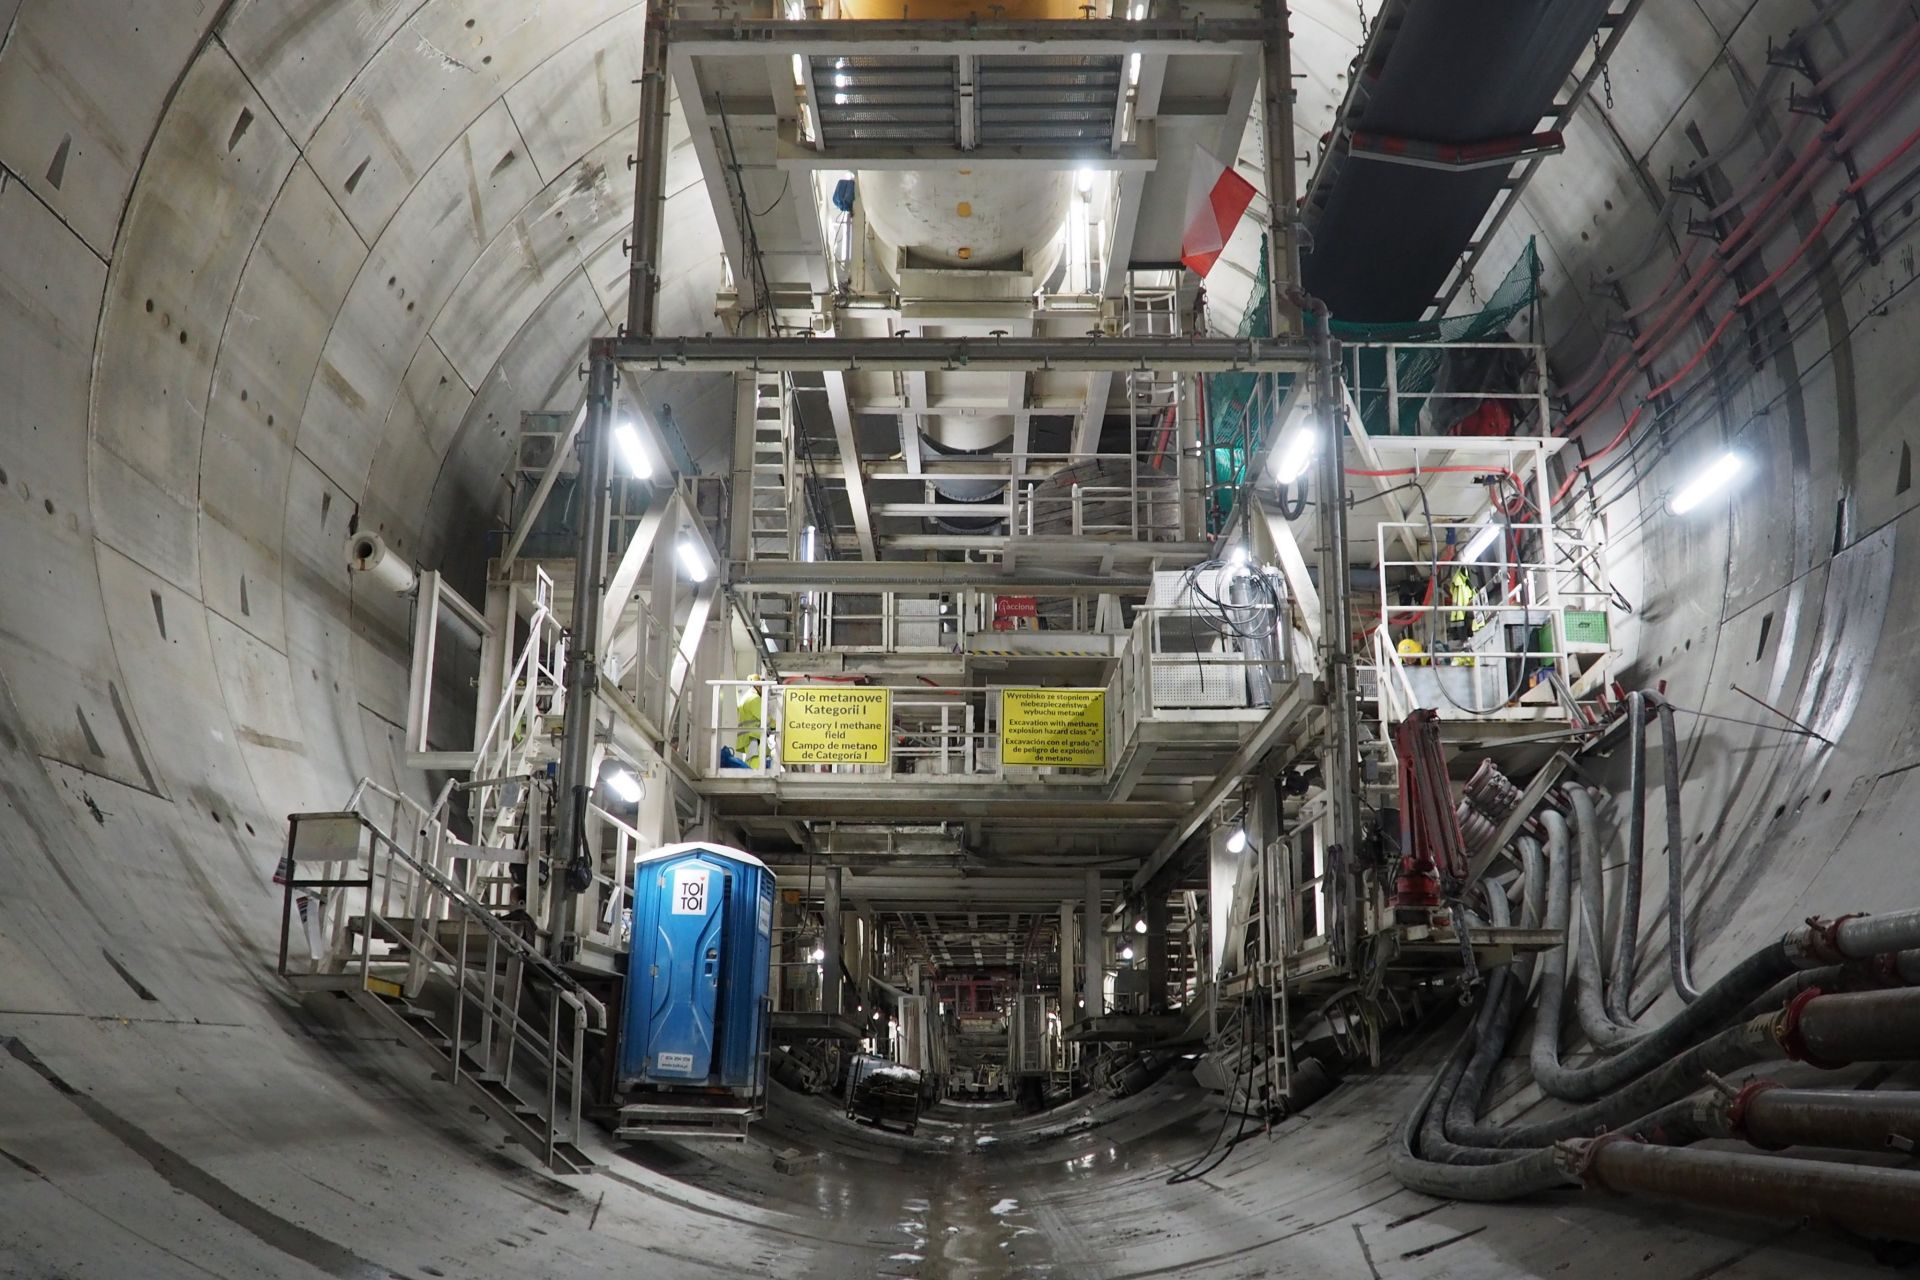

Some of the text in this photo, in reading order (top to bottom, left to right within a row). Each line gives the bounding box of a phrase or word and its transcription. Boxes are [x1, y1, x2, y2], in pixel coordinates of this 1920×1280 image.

[1006, 602, 1034, 611] acciona
[790, 692, 882, 703] Pole metanowe
[1006, 692, 1046, 702] Wyrobisko
[1056, 693, 1090, 702] stopniem
[804, 704, 867, 716] Kategorii I
[1020, 701, 1088, 710] niebezpieczeństwa
[1024, 708, 1085, 717] wybuchu metanu
[789, 720, 882, 731] Category I methane
[1009, 719, 1048, 727] Excavation
[1050, 719, 1066, 727] with
[825, 730, 846, 739] field
[1008, 727, 1043, 736] explosion
[792, 740, 878, 750] Campo de metano
[1069, 739, 1090, 747] grado
[801, 750, 868, 760] de Categoría I
[1023, 746, 1048, 755] peligro
[1060, 747, 1095, 755] explosión
[682, 882, 704, 896] TOI
[680, 896, 702, 911] TOI
